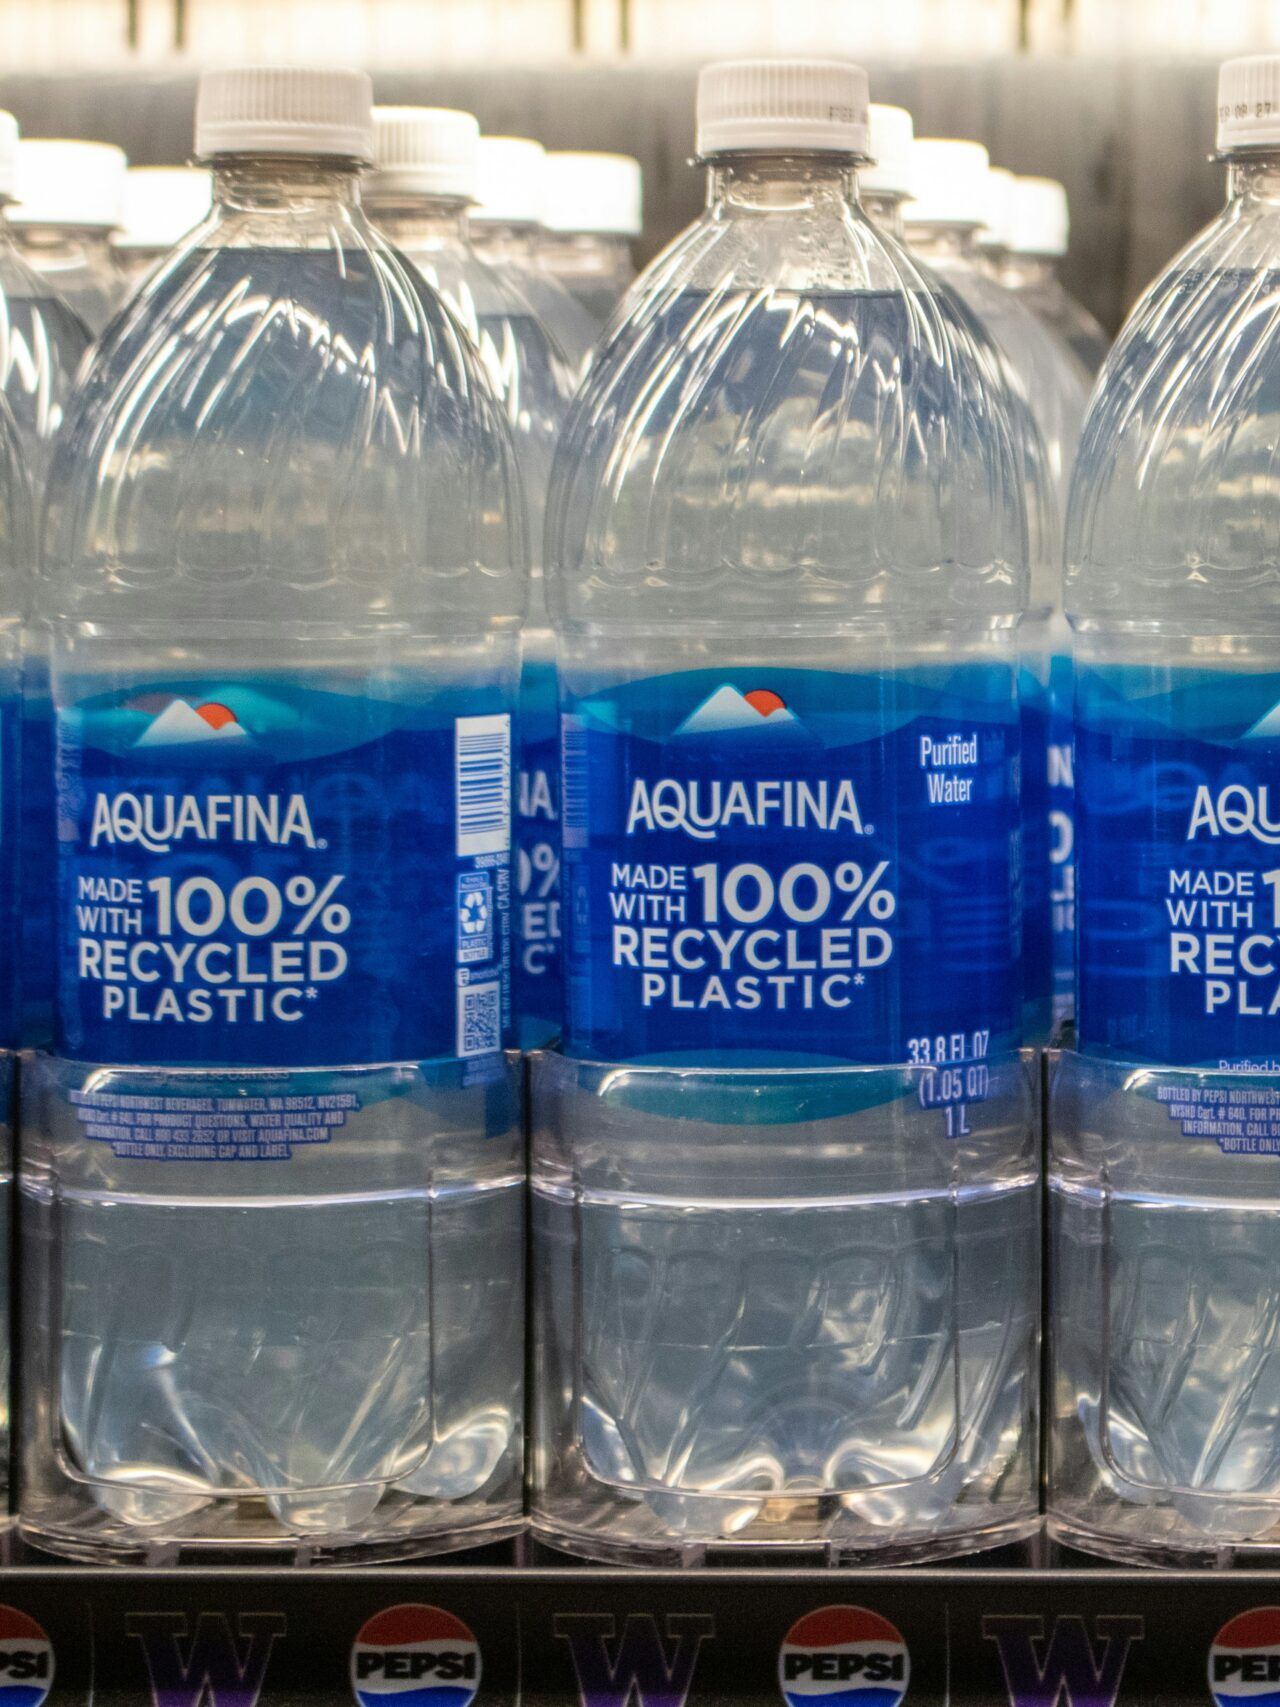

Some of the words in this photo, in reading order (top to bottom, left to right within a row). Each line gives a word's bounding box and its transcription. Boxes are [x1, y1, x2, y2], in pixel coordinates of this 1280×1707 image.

[920, 734, 977, 766] Purified
[927, 773, 973, 803] Water
[80, 877, 141, 902] MADE
[612, 864, 685, 889] MADE
[1170, 871, 1253, 895] MADE
[148, 876, 350, 936] 100%
[610, 893, 685, 921] WITH
[693, 862, 895, 923] 100%
[78, 906, 142, 934] WITH
[1167, 900, 1252, 928] WITH
[80, 941, 347, 983] RECYCLED
[614, 926, 892, 969] RECYCLED
[919, 1068, 962, 1107] (1.05
[967, 1065, 989, 1098] QT)
[945, 1106, 953, 1136] 1
[960, 1105, 970, 1134] L
[125, 1612, 286, 1707] W
[356, 1652, 476, 1680] PEPSI
[553, 1613, 715, 1707] W
[785, 1653, 903, 1681] PEPSI
[982, 1615, 1144, 1707] W
